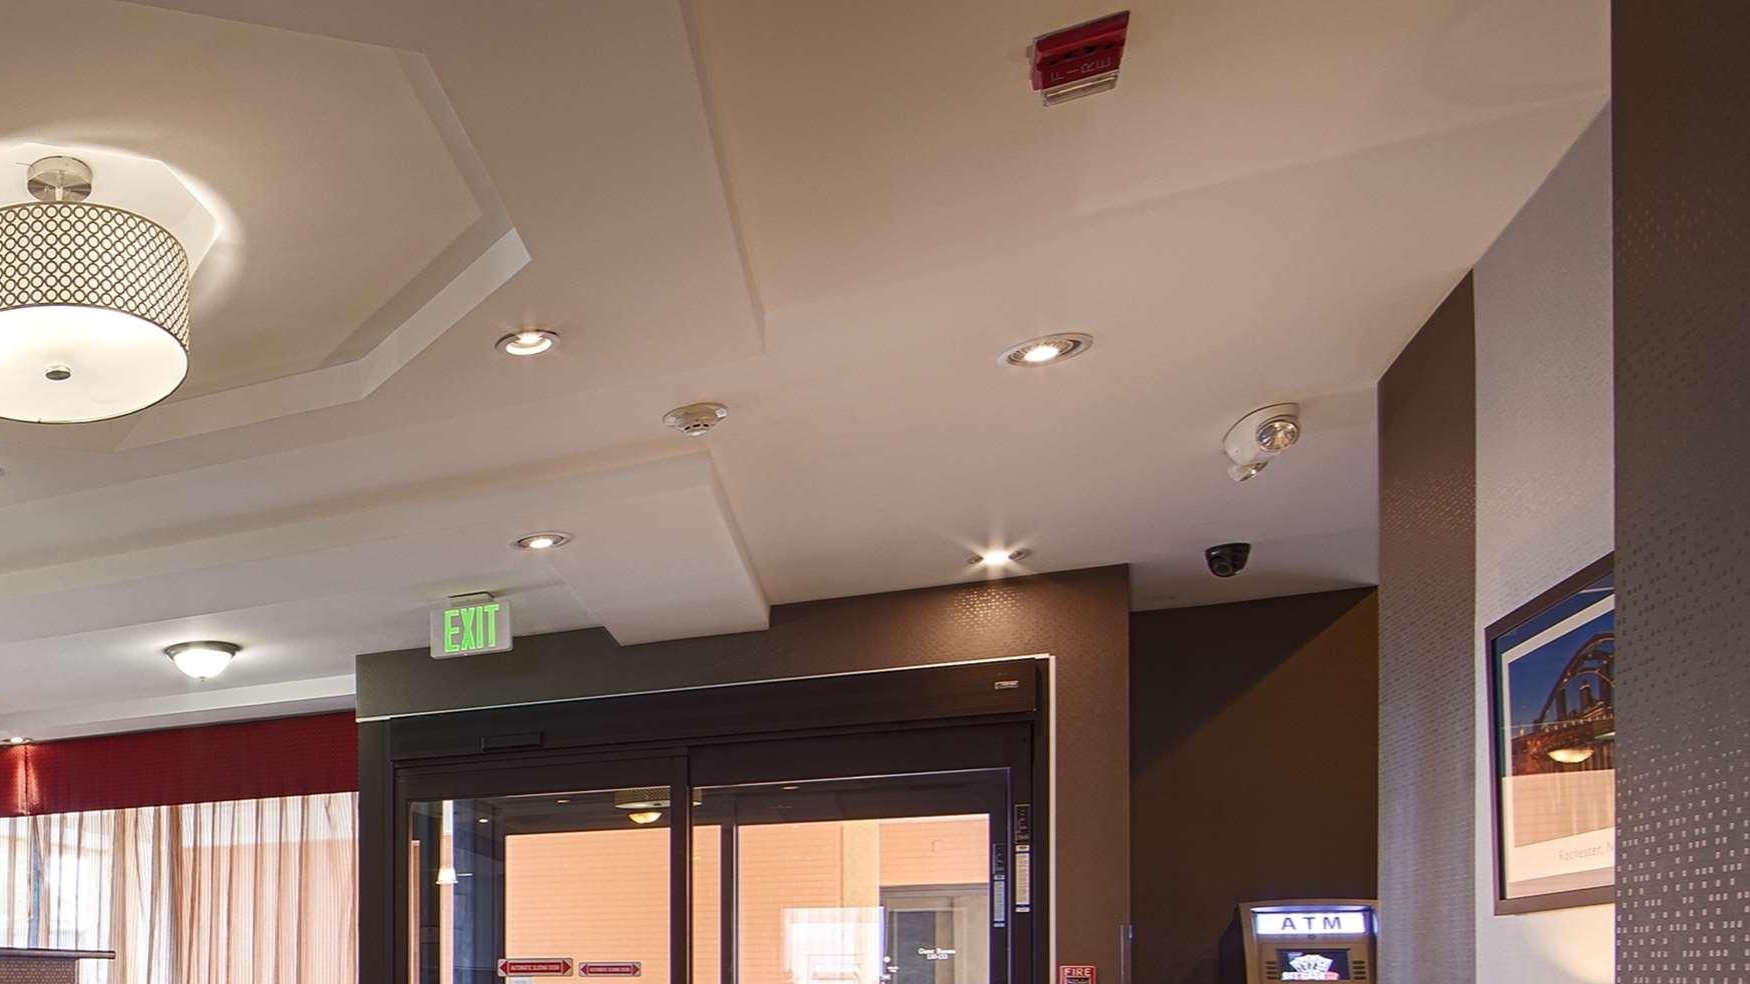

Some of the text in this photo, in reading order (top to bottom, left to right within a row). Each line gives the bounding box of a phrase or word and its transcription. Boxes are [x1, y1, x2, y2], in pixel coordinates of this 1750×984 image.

[1050, 56, 1112, 81] FIRE
[444, 603, 500, 653] EXIT
[1281, 916, 1342, 930] ATM
[1064, 967, 1091, 977] FIRE
